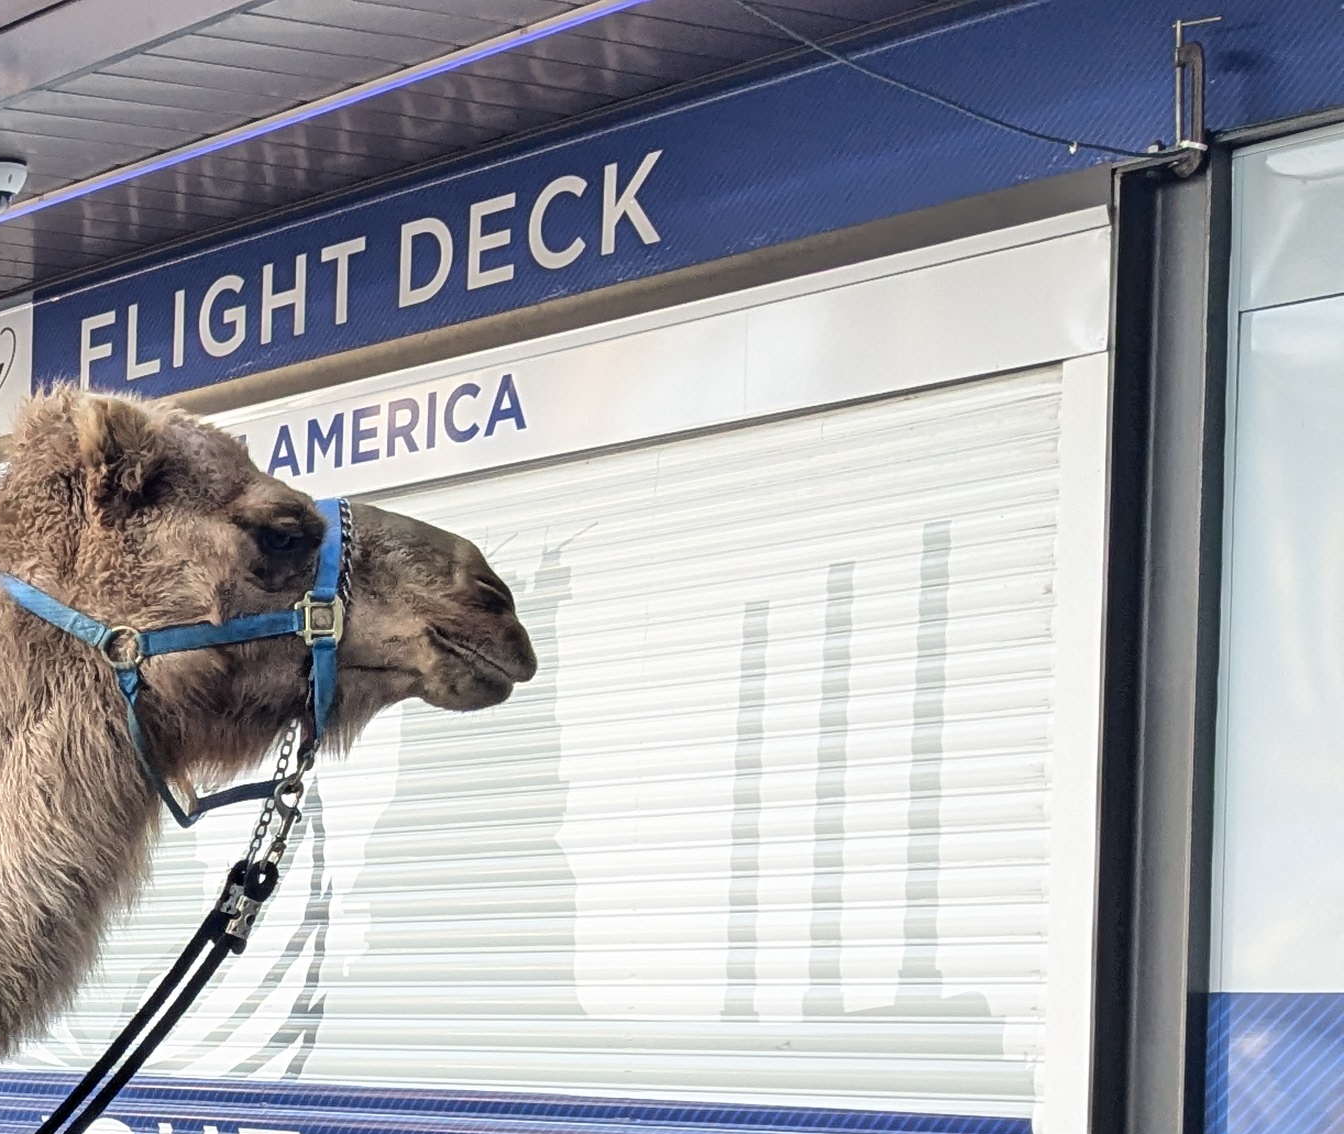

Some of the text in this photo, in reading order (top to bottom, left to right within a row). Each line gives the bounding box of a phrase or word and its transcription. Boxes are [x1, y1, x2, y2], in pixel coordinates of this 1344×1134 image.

[79, 149, 664, 391] FLIGHT DECK
[267, 373, 528, 478] AMERICA
